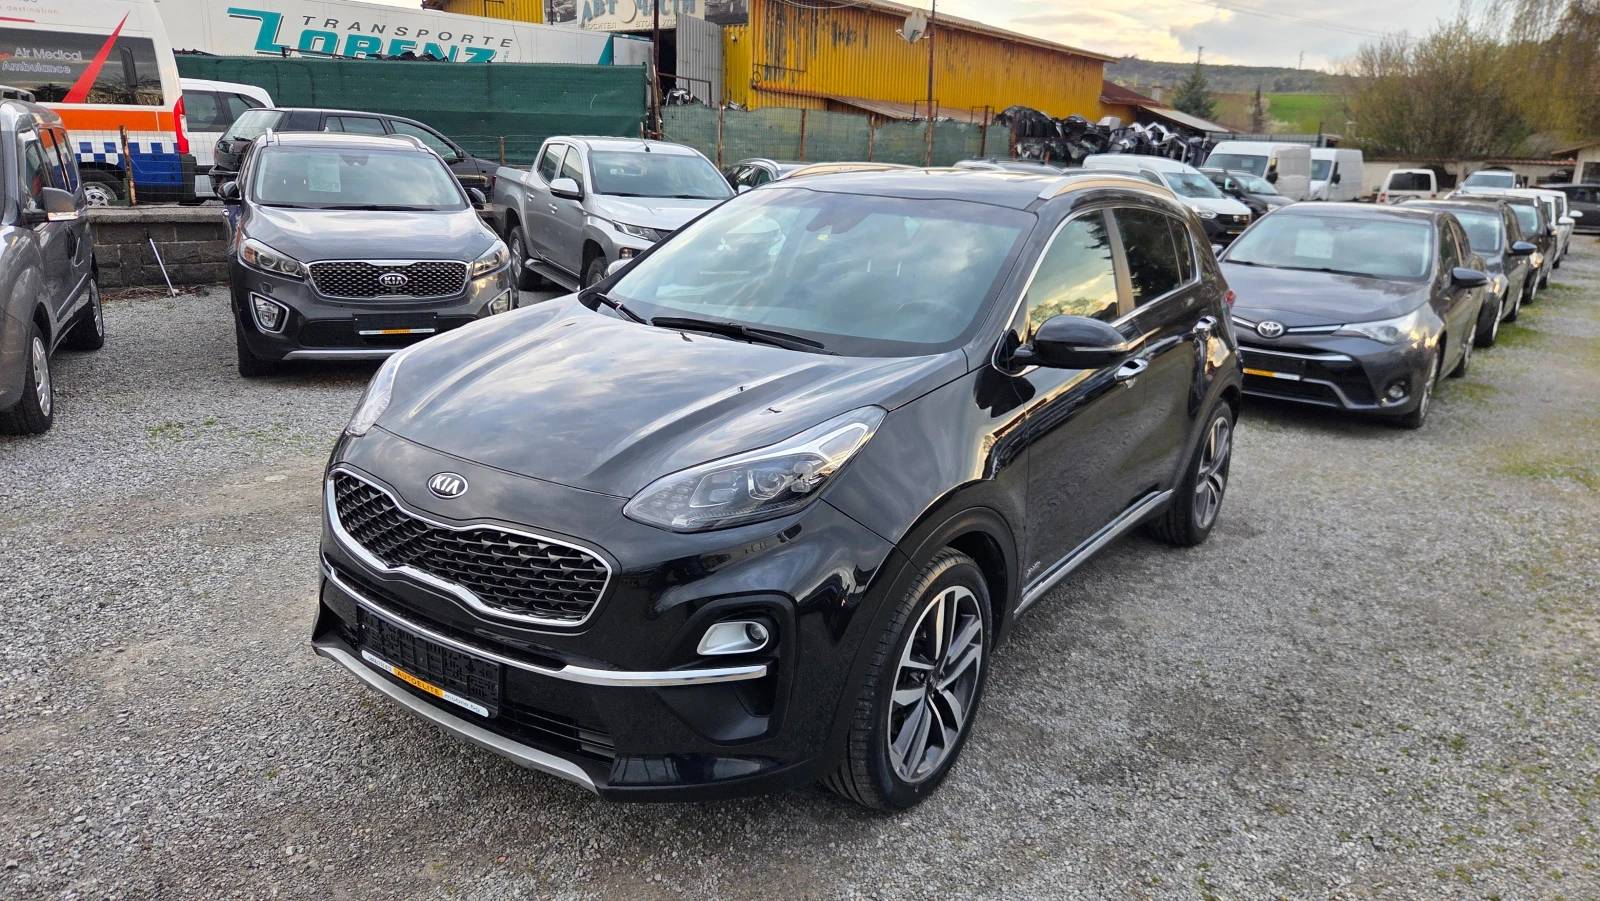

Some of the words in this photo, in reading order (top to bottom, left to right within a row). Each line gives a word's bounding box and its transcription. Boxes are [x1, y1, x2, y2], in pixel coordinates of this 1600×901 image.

[6, 5, 59, 14] destination
[302, 15, 513, 48] TRANSPORTE
[14, 46, 31, 58] Air
[32, 48, 82, 61] Medical
[2, 60, 71, 74] Ambulance
[431, 474, 461, 495] KIA
[397, 671, 441, 695] AUTOELITE
